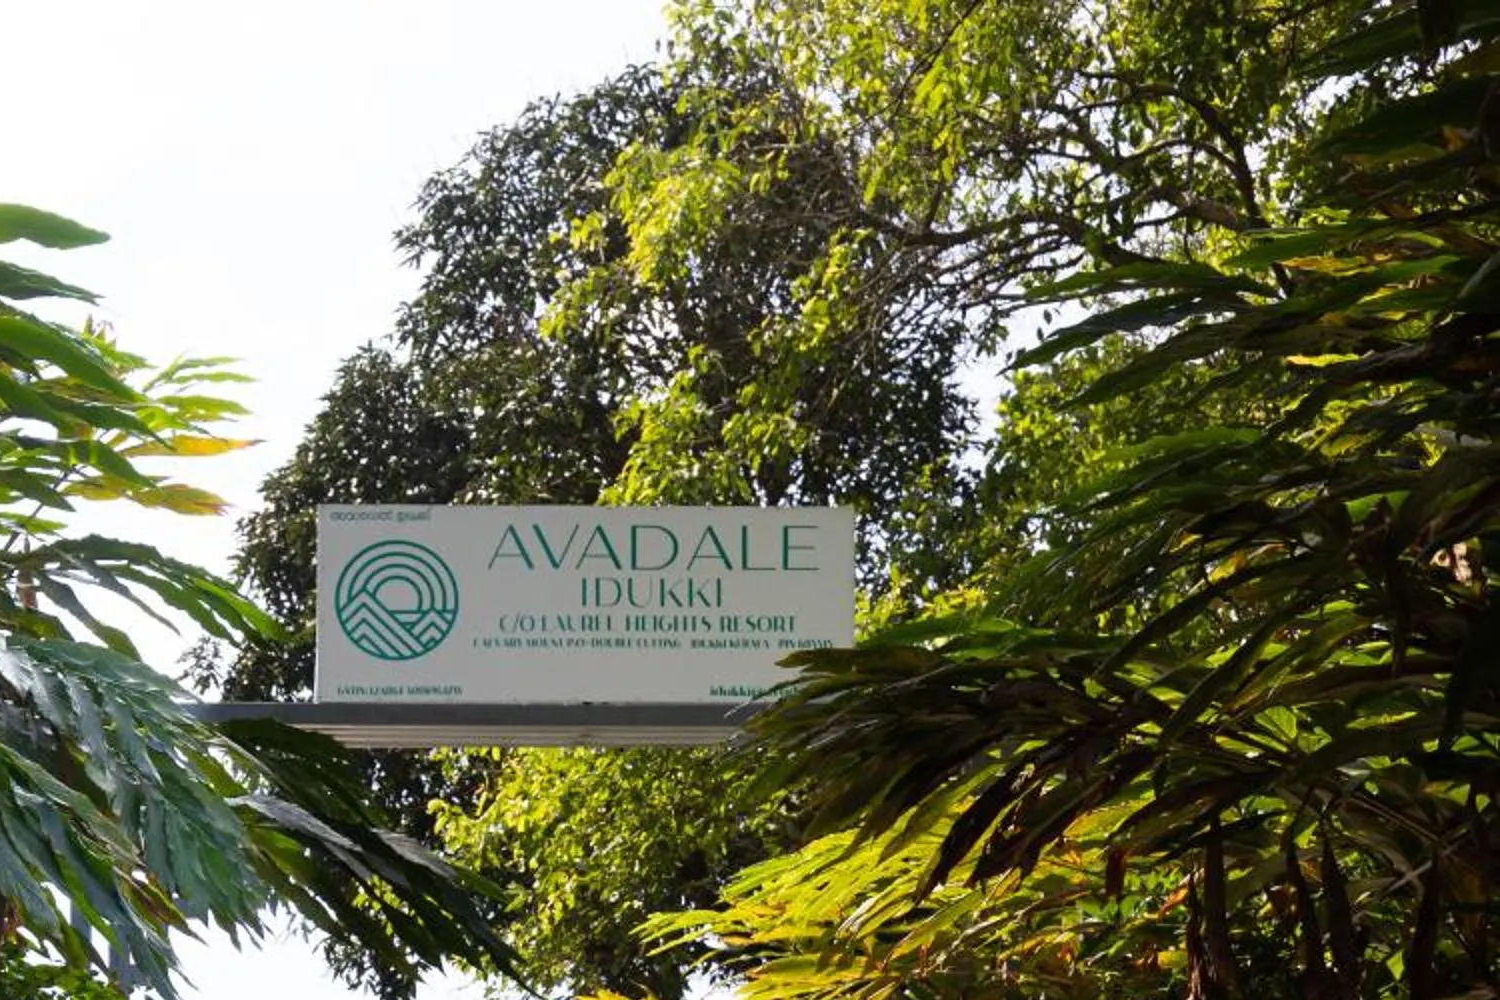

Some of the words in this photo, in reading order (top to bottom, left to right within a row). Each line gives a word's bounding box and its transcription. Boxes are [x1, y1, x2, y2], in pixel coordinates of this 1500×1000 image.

[487, 523, 820, 571] AVADALE
[581, 577, 722, 608] IDUKKI
[541, 614, 614, 632] LAUREL
[625, 615, 712, 633] HEIGHTS
[720, 615, 796, 633] RESORT
